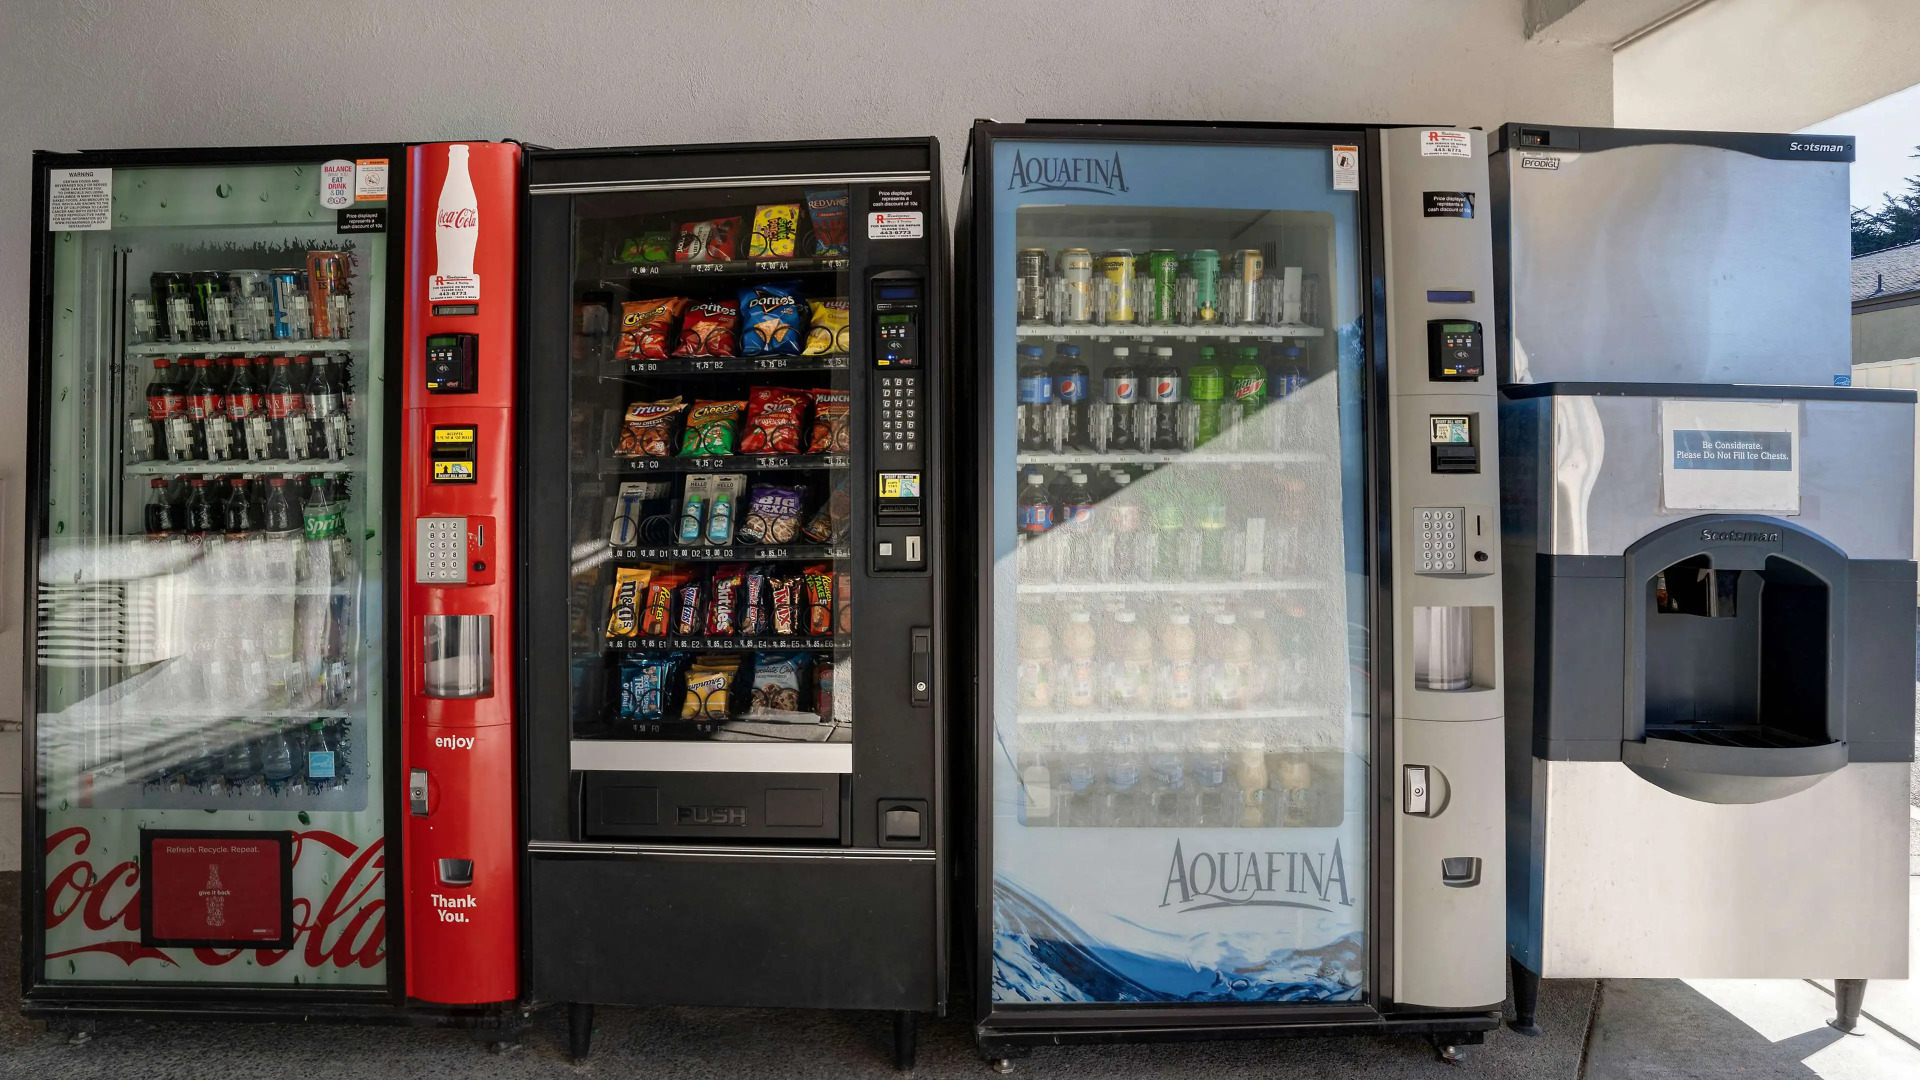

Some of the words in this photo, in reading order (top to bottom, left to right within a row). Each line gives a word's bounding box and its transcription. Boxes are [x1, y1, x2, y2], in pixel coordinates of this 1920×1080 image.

[1429, 132, 1439, 141] R
[1790, 142, 1844, 152] Scotsman
[1008, 148, 1128, 192] AQUAFINA
[876, 214, 884, 224] R
[436, 276, 444, 285] R
[749, 296, 795, 308] Doritos
[690, 303, 737, 316] Doritos
[1733, 451, 1745, 459] Fill
[758, 496, 795, 507] BIG
[753, 503, 797, 514] TEXAS
[1701, 529, 1778, 542] Scotsman
[814, 576, 825, 598] TAKE
[656, 586, 670, 621] Reese's
[435, 735, 475, 750] enjoy
[677, 807, 746, 824] PUSH
[1159, 837, 1353, 907] AQUAFINA
[431, 894, 477, 907] Thank
[438, 909, 469, 923] You.
